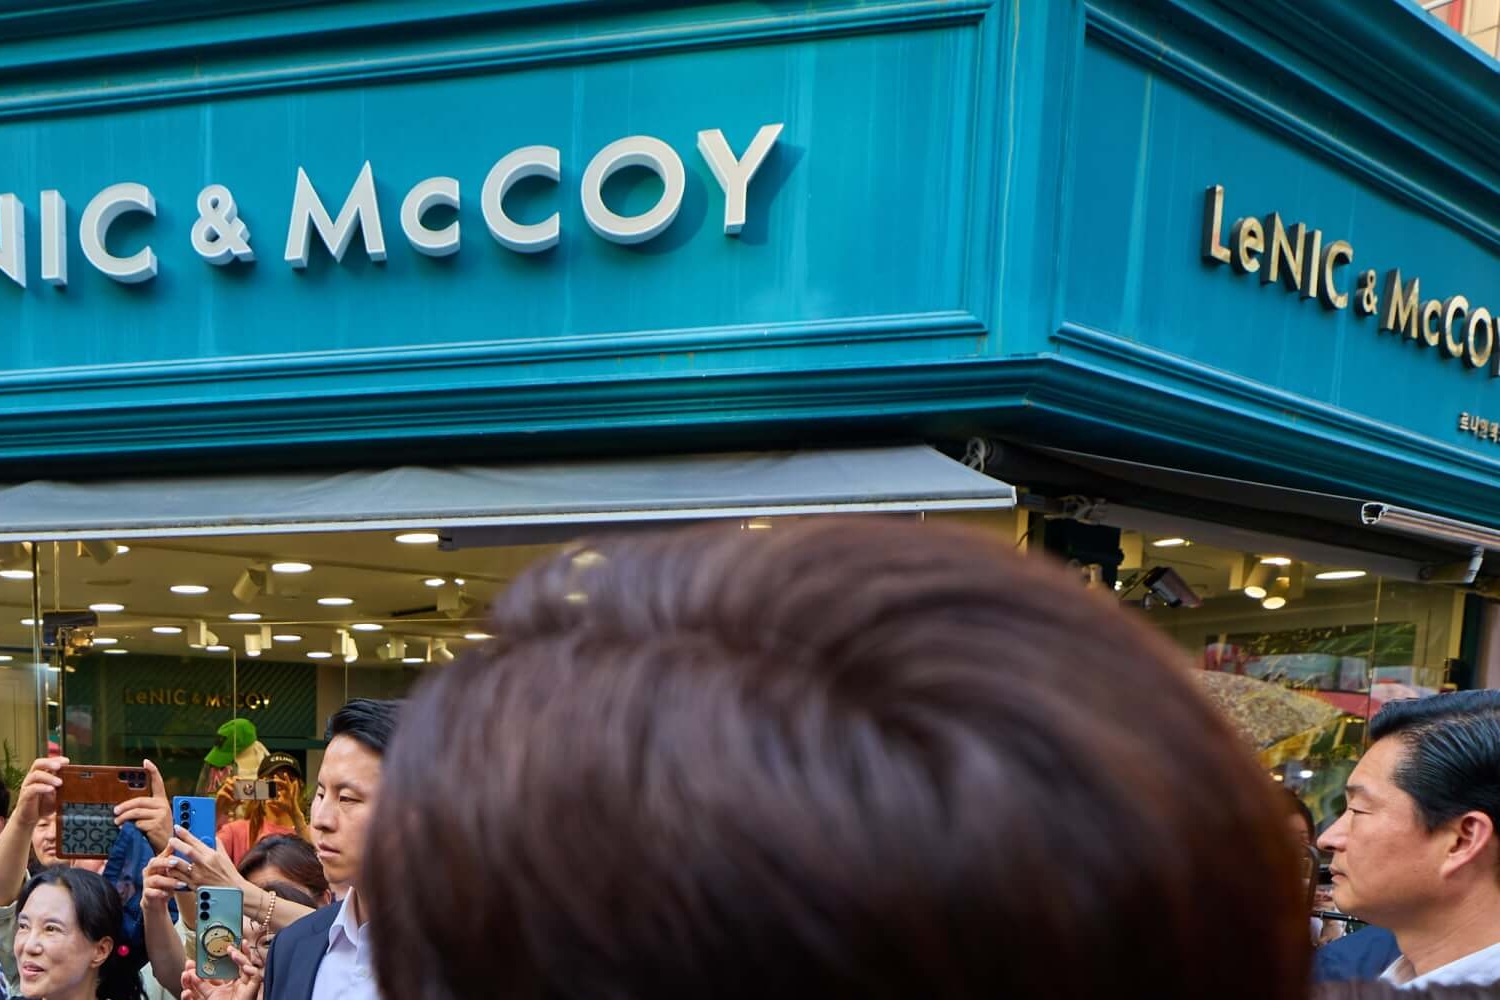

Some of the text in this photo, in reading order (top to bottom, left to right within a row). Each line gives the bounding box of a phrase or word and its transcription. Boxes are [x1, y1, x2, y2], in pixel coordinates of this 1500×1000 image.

[191, 184, 256, 265] &
[284, 122, 784, 269] McCOY
[1203, 184, 1500, 378] LeNIC & McCO
[125, 688, 187, 706] LeNIC
